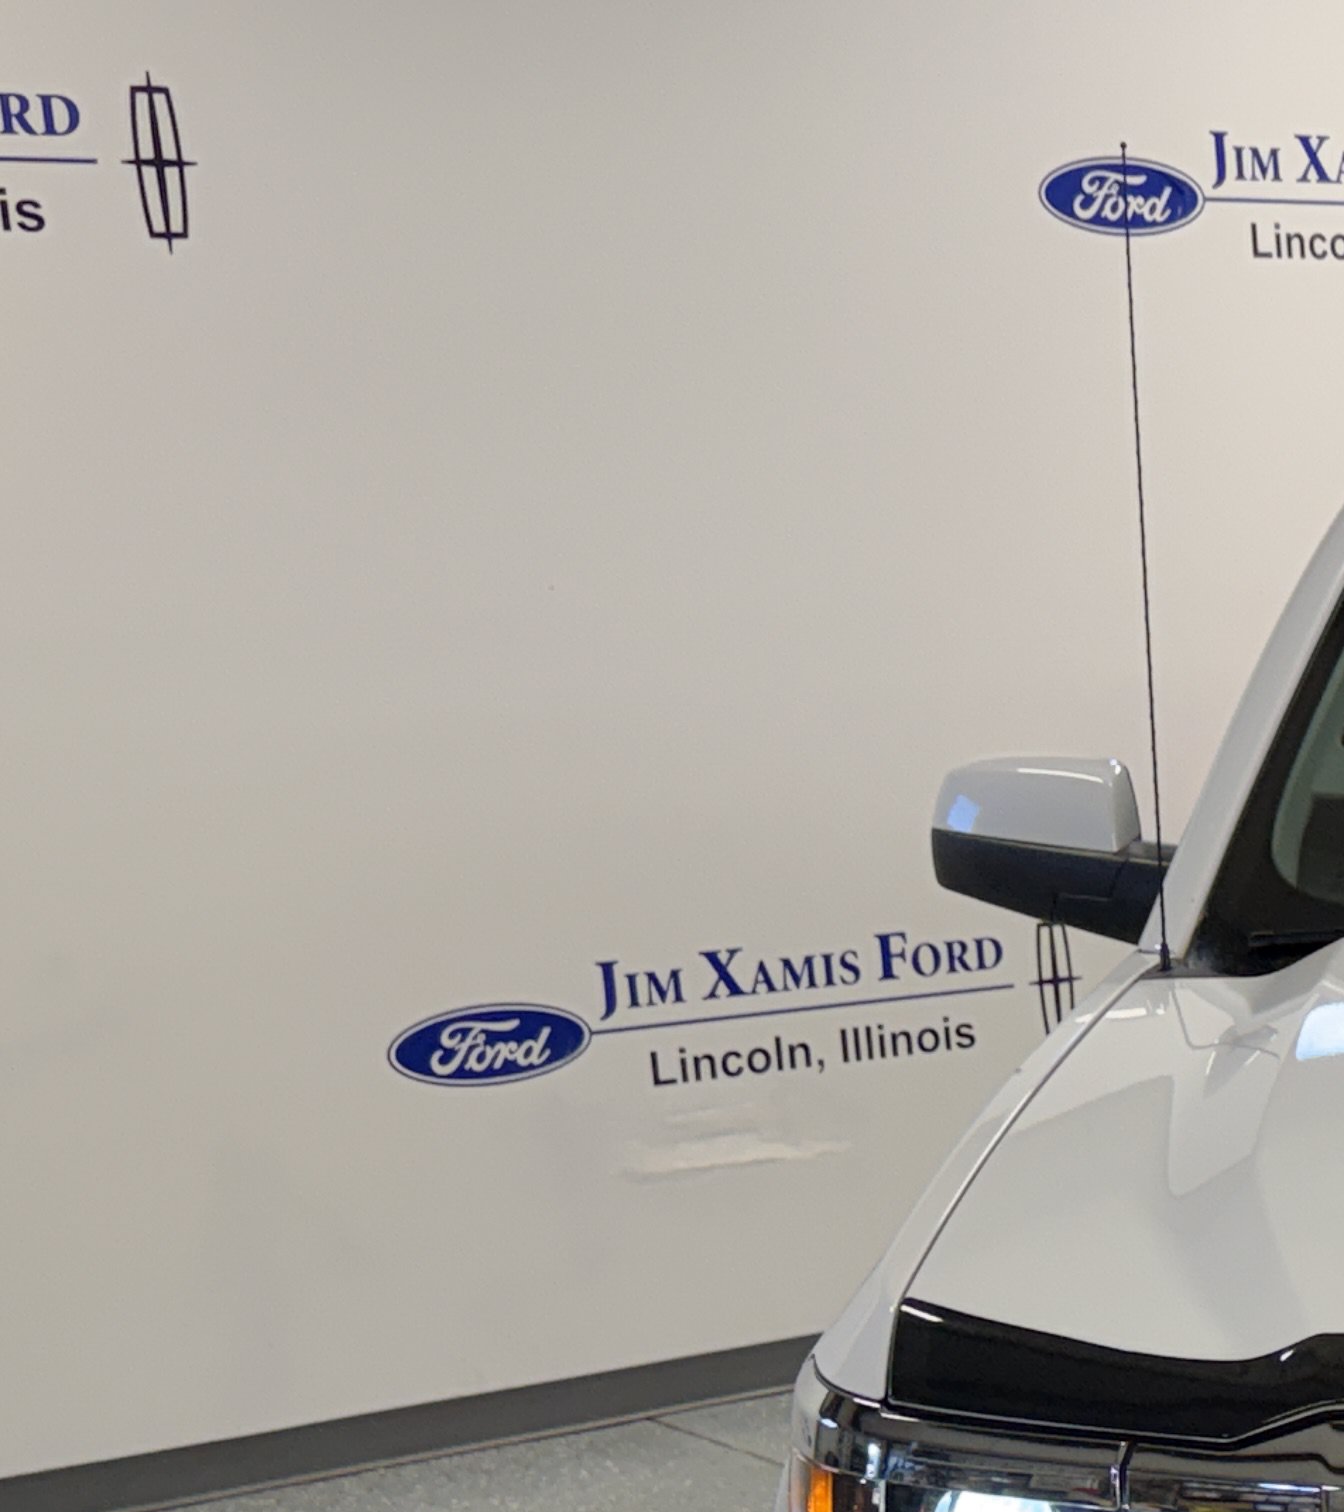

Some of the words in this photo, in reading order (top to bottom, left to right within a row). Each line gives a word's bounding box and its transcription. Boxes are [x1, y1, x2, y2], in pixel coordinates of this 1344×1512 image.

[1208, 129, 1284, 190] JIM
[1072, 169, 1172, 222] Ford
[594, 959, 687, 1022] JIM
[697, 947, 862, 1002] XAMIS
[873, 930, 1004, 983] FORD
[430, 1018, 552, 1076] Ford
[649, 1034, 826, 1088] Lincoln,
[839, 1015, 977, 1071] Illinois
